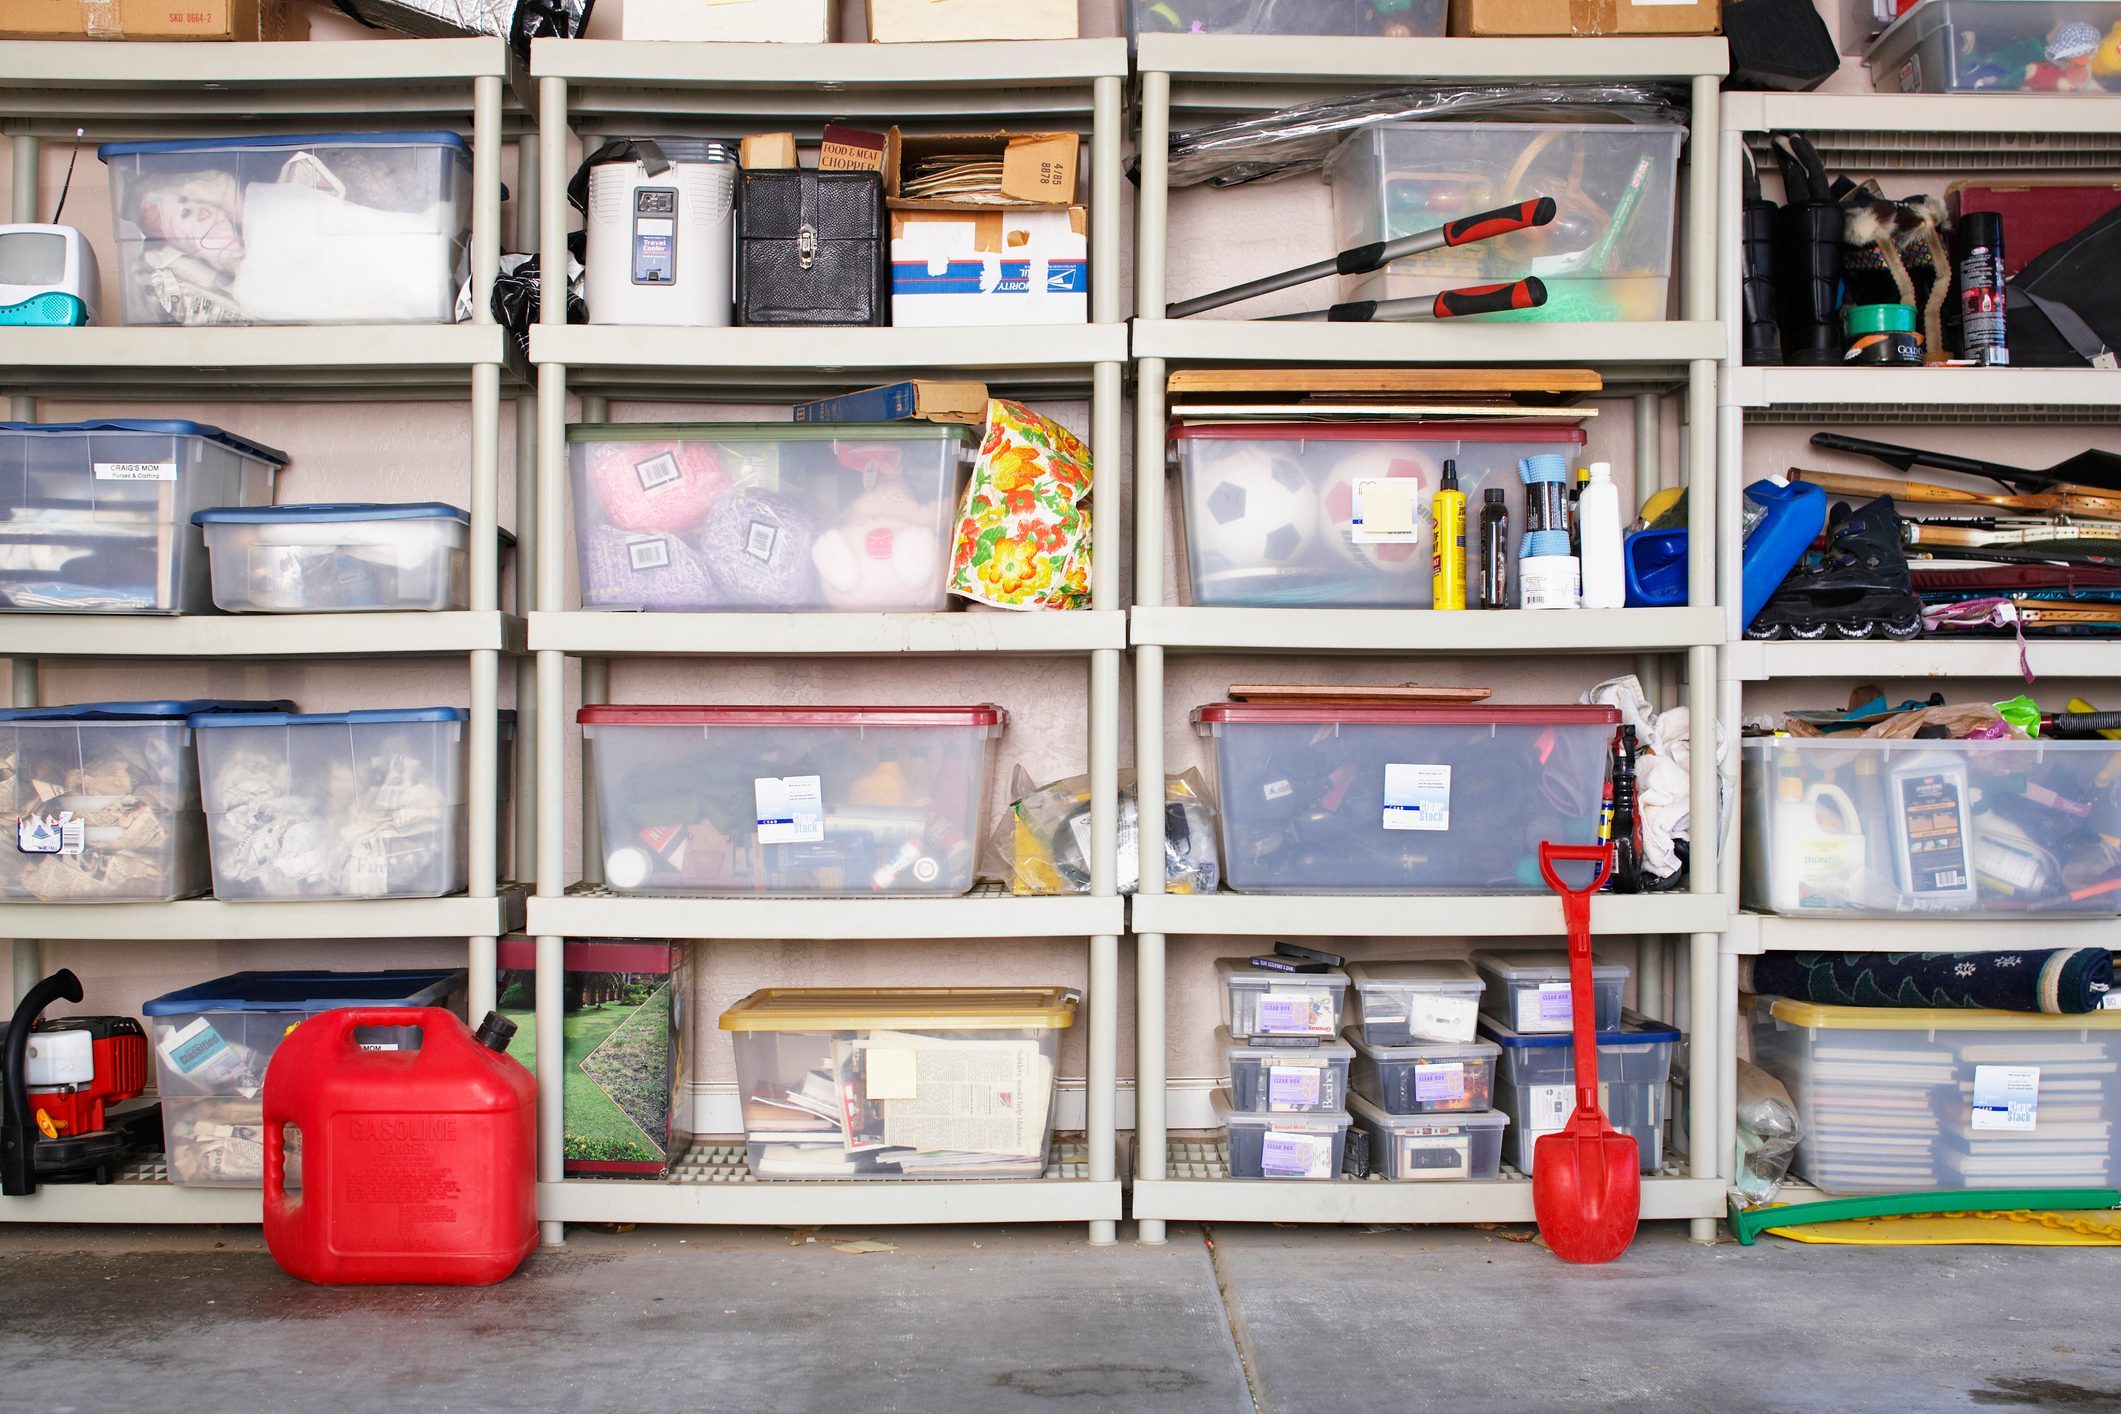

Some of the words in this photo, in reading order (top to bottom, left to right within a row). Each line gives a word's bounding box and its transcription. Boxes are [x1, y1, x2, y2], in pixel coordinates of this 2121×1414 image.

[170, 13, 182, 22] SKU
[823, 144, 848, 155] FOOD
[849, 148, 855, 157] &
[856, 150, 878, 160] MEAT
[822, 157, 875, 170] CHOPPER
[1040, 162, 1051, 184] 8878
[1052, 163, 1064, 185] 4/85
[111, 464, 140, 472] CRAIG'S
[141, 464, 159, 472] MOM
[1323, 1070, 1334, 1109] Beaches
[350, 1119, 457, 1141] GASOLINE
[380, 1143, 427, 1155] DANGER
